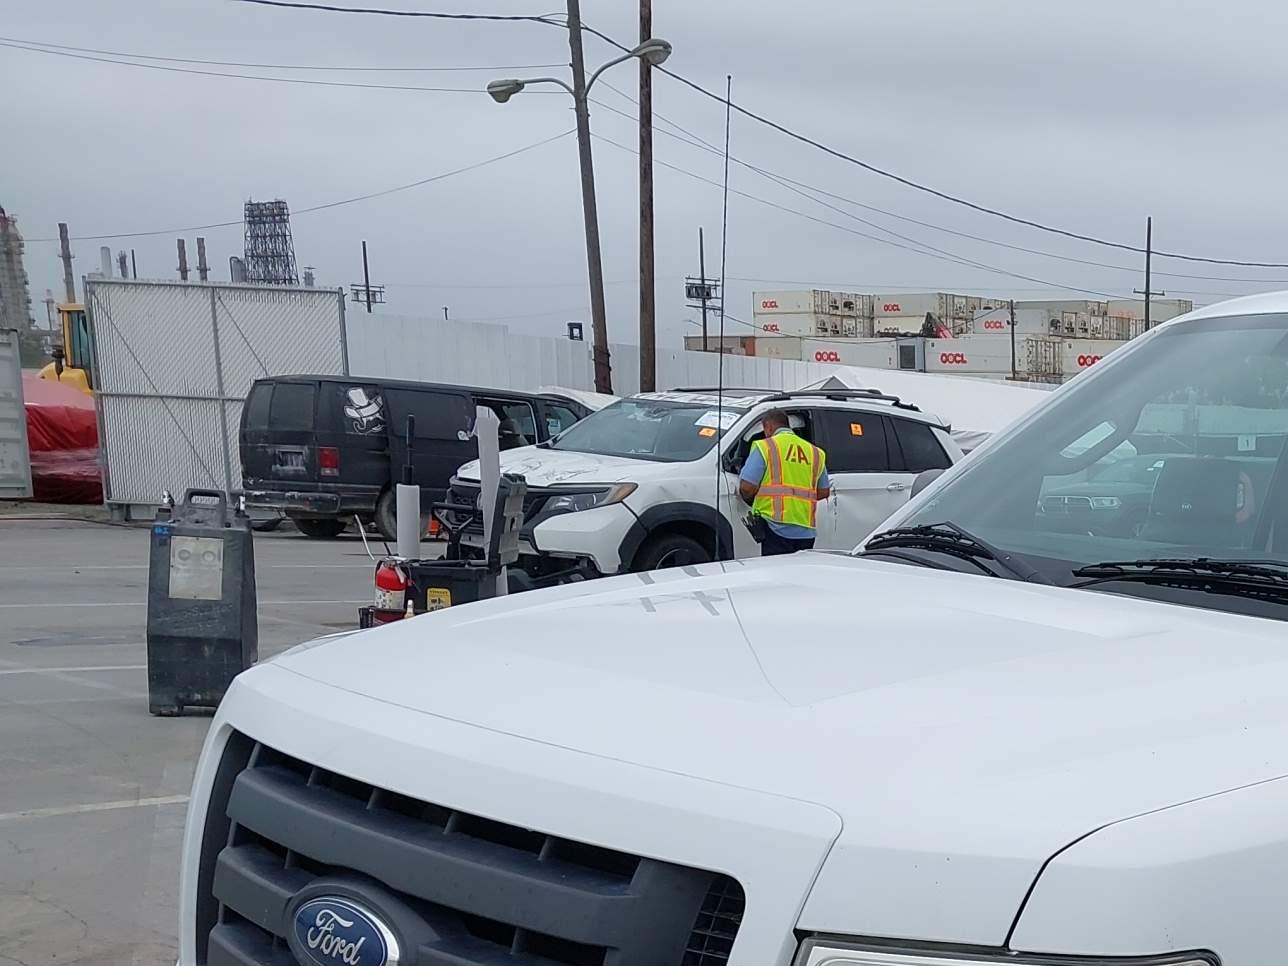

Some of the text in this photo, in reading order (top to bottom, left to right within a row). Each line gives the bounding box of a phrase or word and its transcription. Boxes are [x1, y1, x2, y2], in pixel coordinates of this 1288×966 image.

[815, 351, 841, 362] OOCL
[940, 352, 967, 364] OOCL
[307, 908, 366, 966] Ford
